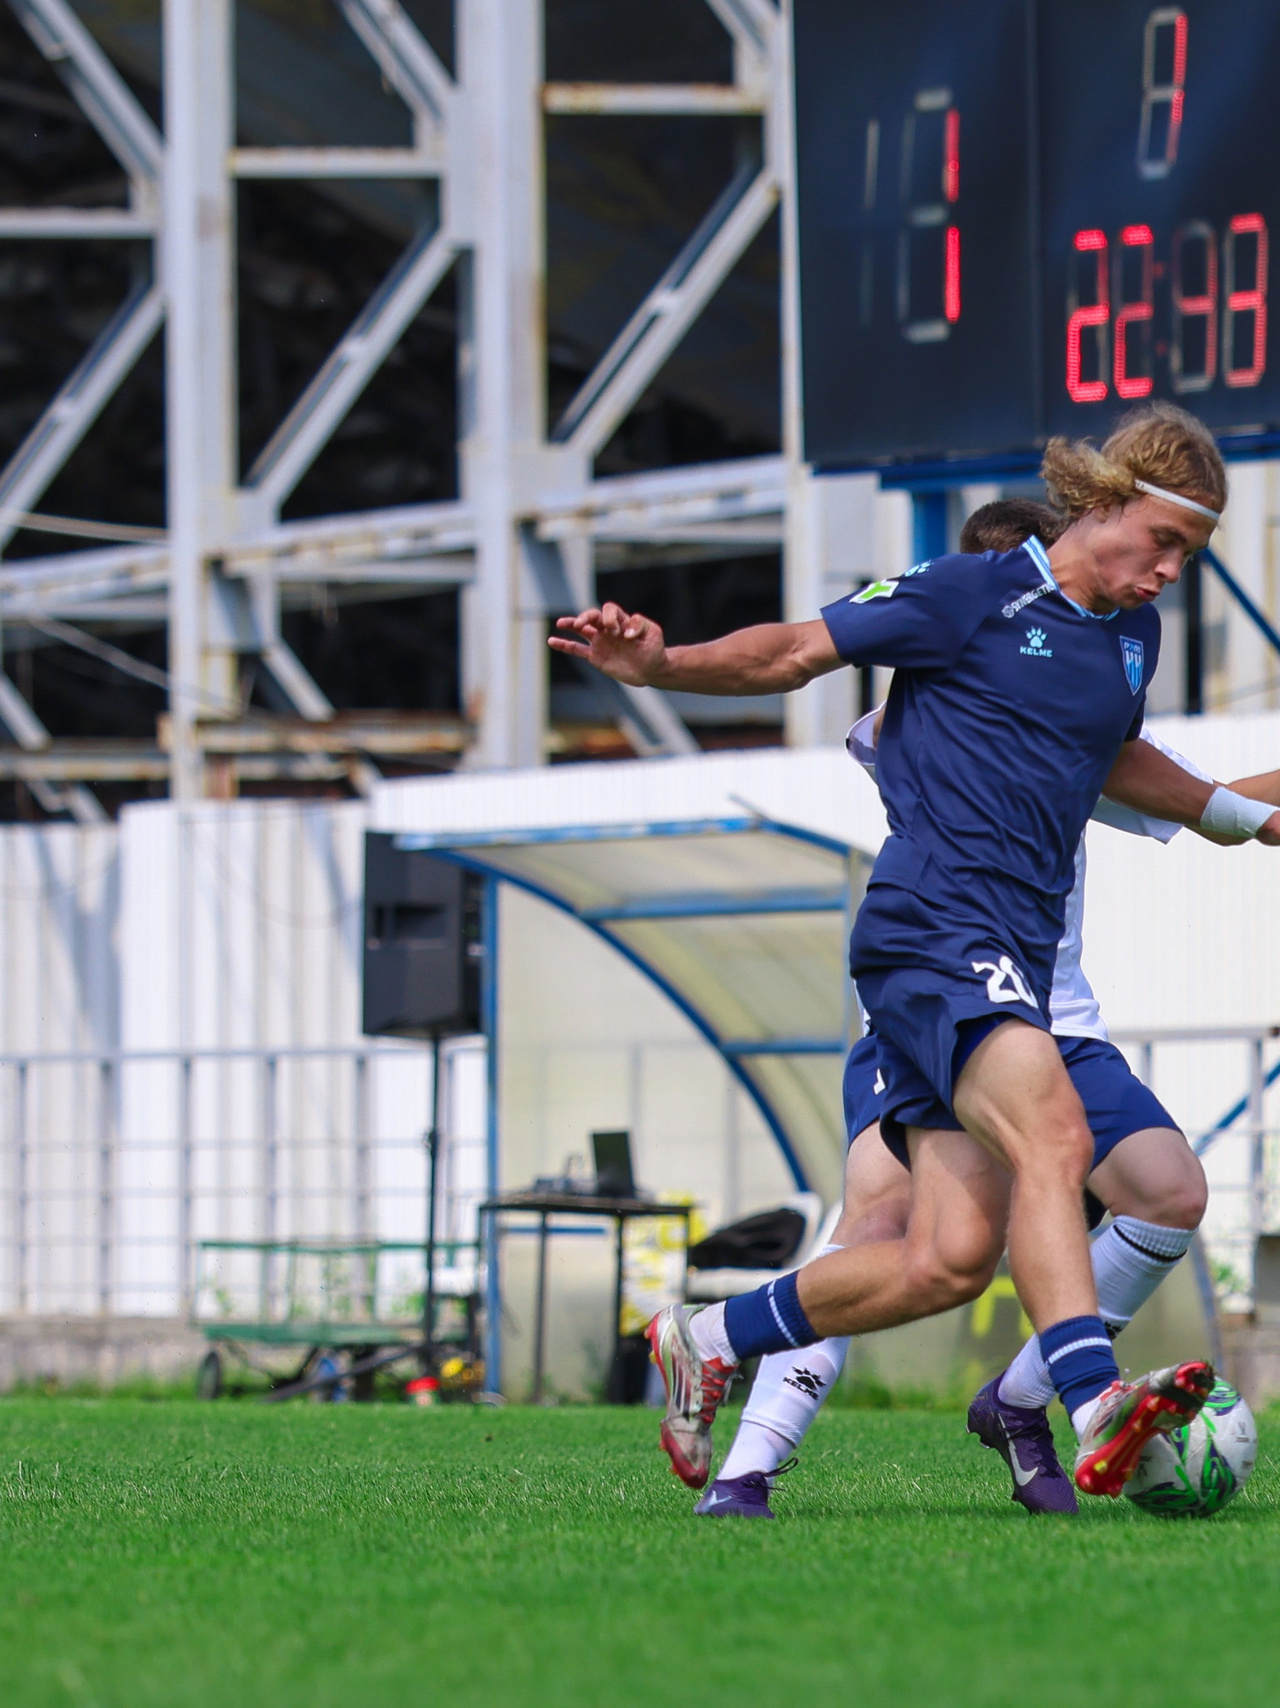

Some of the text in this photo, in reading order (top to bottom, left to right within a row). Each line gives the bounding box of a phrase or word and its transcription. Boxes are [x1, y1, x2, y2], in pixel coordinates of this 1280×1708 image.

[945, 108, 960, 323] 1
[1020, 646, 1053, 658] KELME
[783, 1376, 819, 1400] KELME
